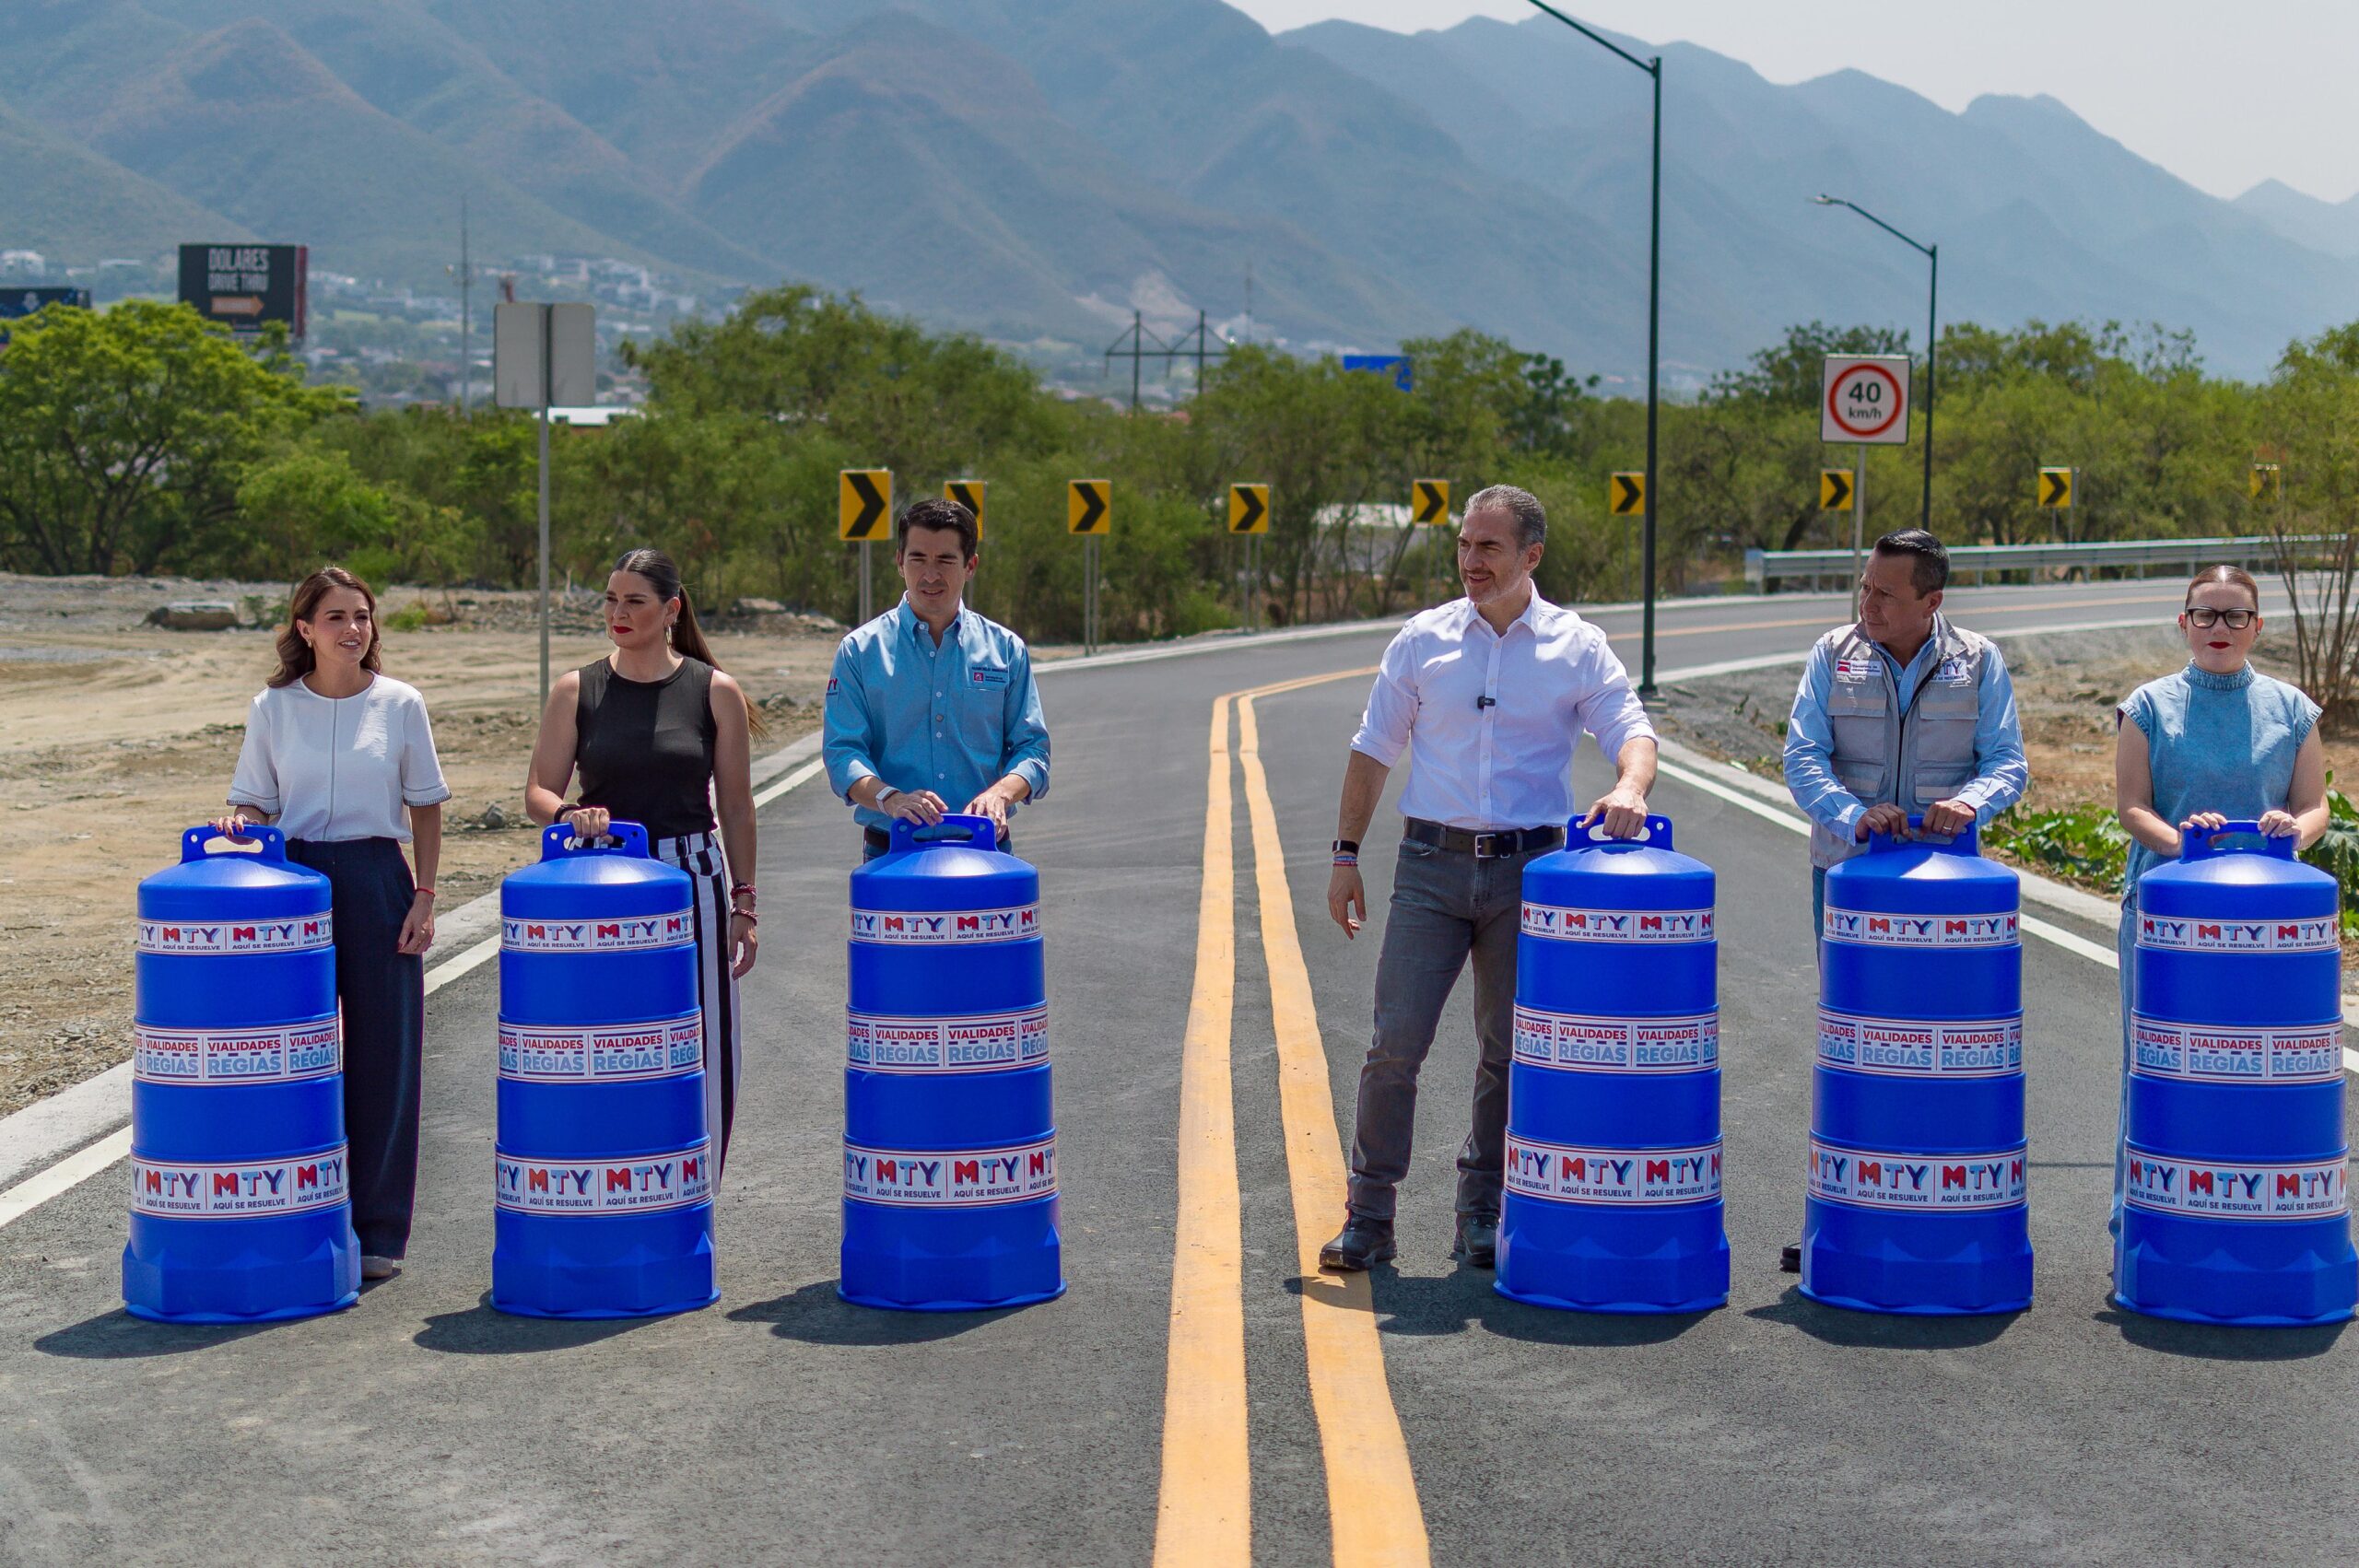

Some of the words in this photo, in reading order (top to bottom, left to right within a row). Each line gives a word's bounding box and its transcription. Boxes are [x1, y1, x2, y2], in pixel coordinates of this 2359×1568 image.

[208, 248, 270, 271] DOLARES
[1848, 381, 1882, 404] 40
[1848, 407, 1882, 420] km/h
[885, 917, 945, 932] MTY
[957, 913, 1014, 930] MTY
[1566, 914, 1629, 930] MTY
[1641, 916, 1696, 930] MTY
[1870, 918, 1933, 935] MTY
[1946, 919, 2001, 935] MTY
[2144, 919, 2188, 938] MTY
[162, 928, 220, 942] MTY
[233, 924, 294, 942] MTY
[527, 925, 585, 941] MTY
[597, 921, 658, 940] MTY
[2199, 924, 2265, 941] MTY
[2278, 922, 2327, 941] MTY
[289, 1032, 335, 1047] VIALIDADES
[875, 1030, 938, 1040] VIALIDADES
[948, 1026, 1015, 1039] VIALIDADES
[1559, 1026, 1627, 1040] VIALIDADES
[1637, 1028, 1698, 1040] VIALIDADES
[1863, 1031, 1932, 1044] VIALIDADES
[1942, 1034, 2003, 1044] VIALIDADES
[146, 1041, 198, 1051] VIALIDADES
[207, 1040, 280, 1052] VIALIDADES
[522, 1039, 583, 1049] VIALIDADES
[593, 1036, 663, 1047] VIALIDADES
[2189, 1037, 2262, 1049] VIALIDADES
[2272, 1038, 2330, 1049] VIALIDADES
[290, 1047, 335, 1068] REGIAS
[876, 1047, 939, 1062] REGIAS
[948, 1043, 1015, 1061] REGIAS
[1559, 1043, 1627, 1061] REGIAS
[1637, 1045, 1697, 1062] REGIAS
[1862, 1047, 1931, 1066] REGIAS
[1942, 1048, 2003, 1066] REGIAS
[147, 1057, 198, 1073] REGIAS
[207, 1057, 281, 1073] REGIAS
[523, 1056, 584, 1071] REGIAS
[593, 1052, 663, 1071] REGIAS
[2189, 1054, 2262, 1072] REGIAS
[2272, 1054, 2330, 1072] REGIAS
[1508, 1145, 1551, 1178] MTY
[298, 1157, 343, 1190] MTY
[607, 1163, 673, 1193] MTY
[876, 1159, 941, 1187] MTY
[955, 1156, 1020, 1187] MTY
[1562, 1156, 1633, 1185] MTY
[1647, 1156, 1704, 1185] MTY
[1859, 1160, 1930, 1190] MTY
[1942, 1163, 2003, 1190] MTY
[2130, 1158, 2177, 1192] MTY
[146, 1169, 200, 1198] MTY
[214, 1169, 286, 1198] MTY
[529, 1168, 593, 1195] MTY
[2189, 1169, 2263, 1199] MTY
[2277, 1169, 2333, 1198] MTY
[298, 1194, 313, 1203] AQUÍ
[323, 1187, 343, 1198] RESUELVE
[606, 1197, 626, 1206] AQUÍ
[640, 1193, 674, 1203] RESUELVE
[876, 1188, 892, 1197] AQUÍ
[954, 1188, 973, 1198] AQUÍ
[987, 1186, 1020, 1196] RESUELVE
[1561, 1186, 1579, 1194] AQUÍ
[1593, 1188, 1632, 1197] RESUELVE
[1645, 1188, 1663, 1197] AQUÍ
[1676, 1186, 1704, 1196] RESUELVE
[1858, 1189, 1874, 1199] AQUÍ
[1889, 1193, 1928, 1202] RESUELVE
[1942, 1193, 1960, 1202] AQUÍ
[1962, 1194, 1971, 1202] SE
[1974, 1192, 2002, 1201] RESUELVE
[167, 1201, 200, 1210] RESUELVE
[213, 1200, 232, 1210] AQUÍ
[247, 1199, 286, 1208] RESUELVE
[2189, 1199, 2207, 1208] AQUÍ
[2210, 1200, 2220, 1209] SE
[2222, 1202, 2262, 1211] RESUELVE
[2276, 1201, 2294, 1211] AQUÍ
[2296, 1201, 2305, 1211] SE
[2307, 1199, 2333, 1209] RESUELVE
